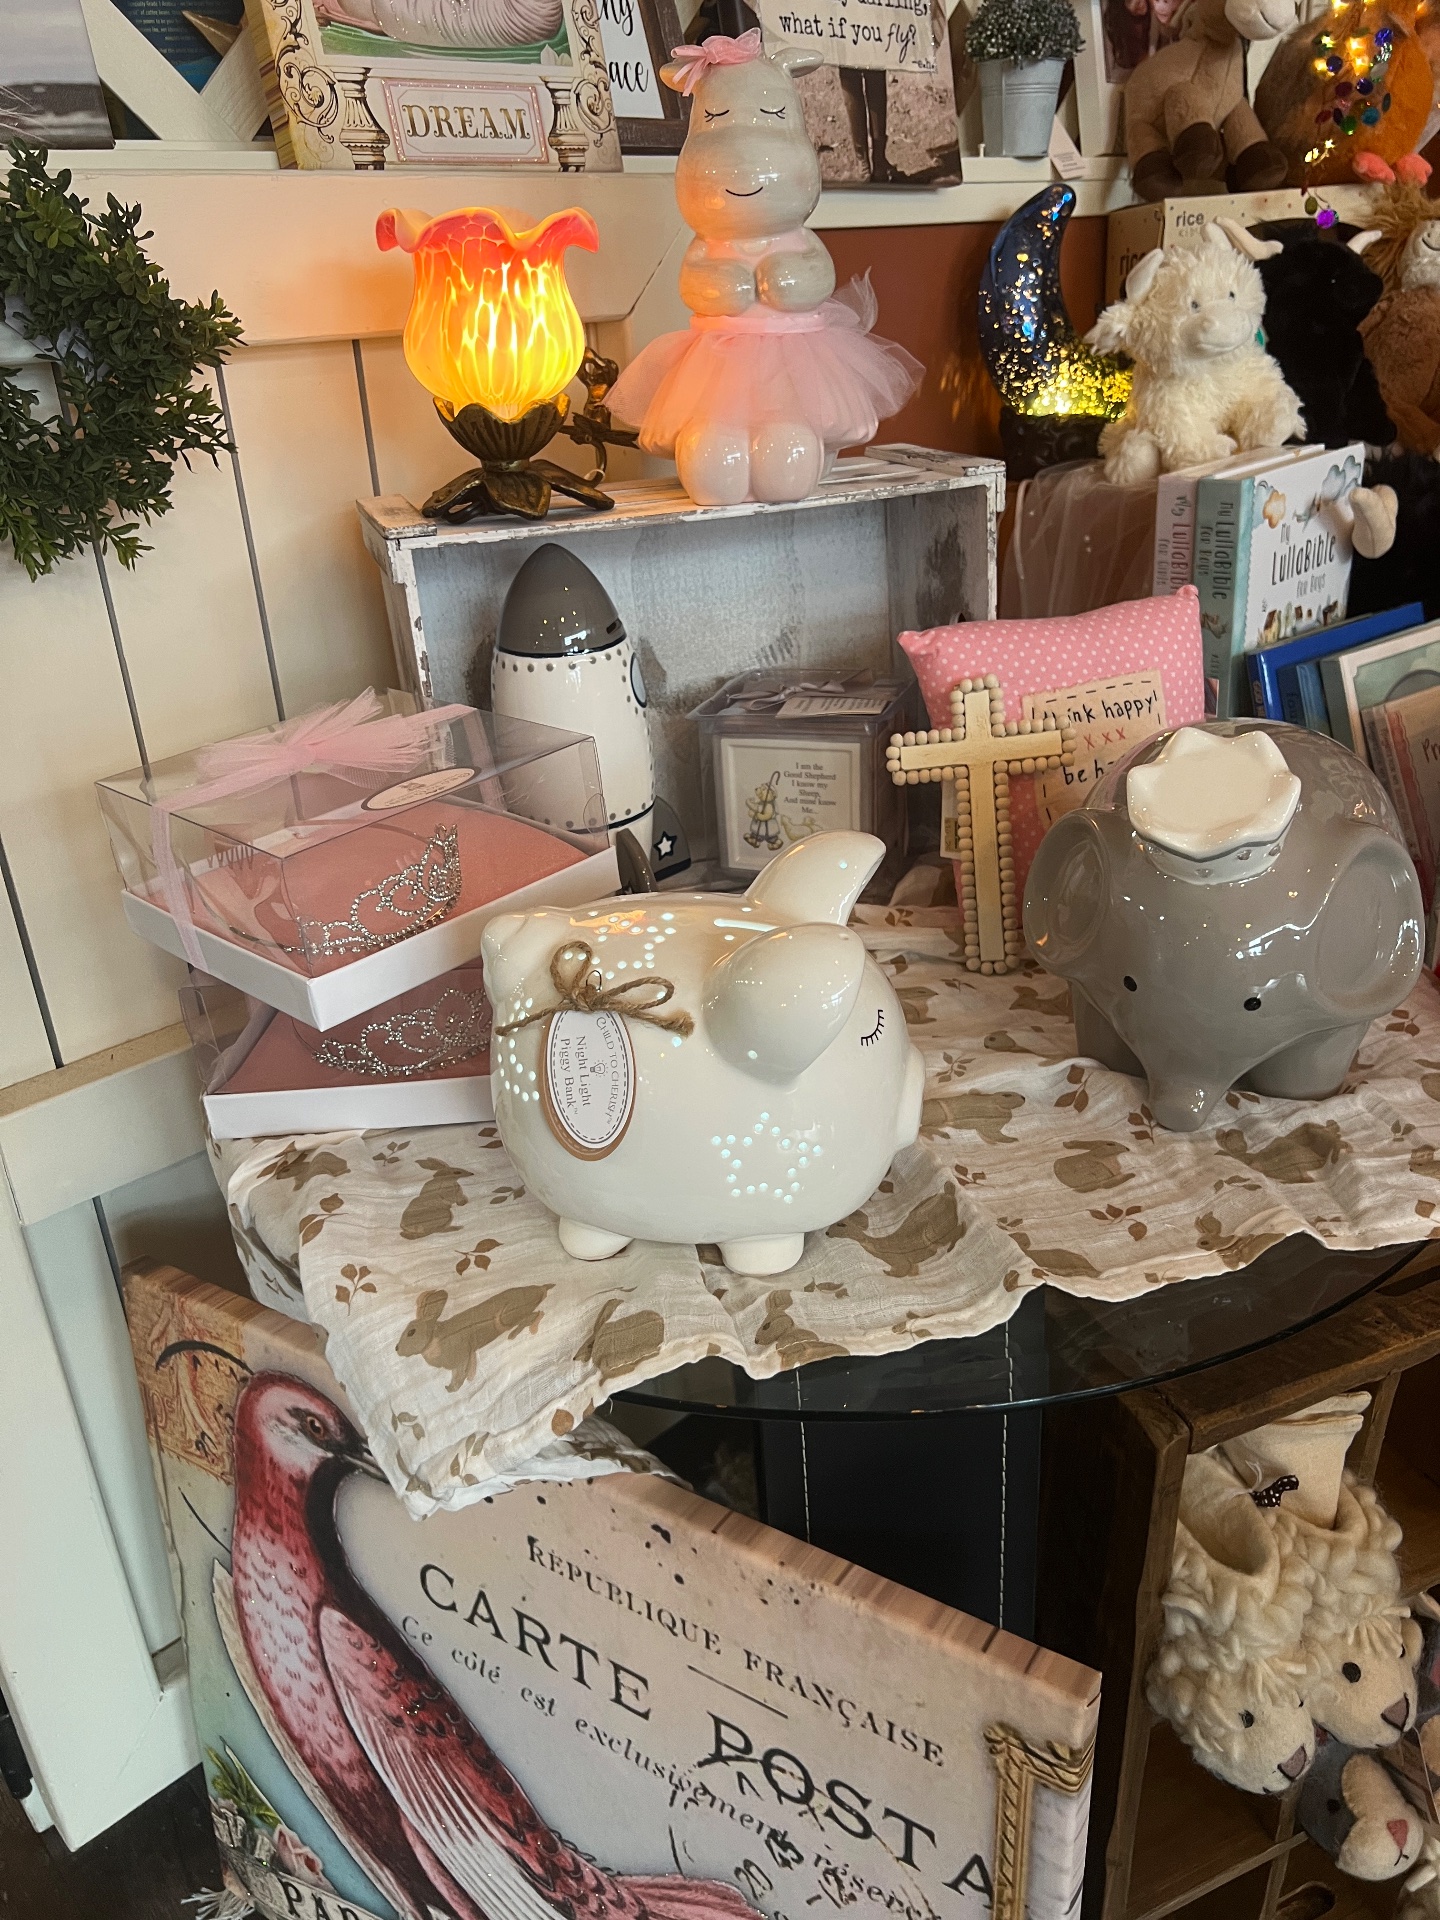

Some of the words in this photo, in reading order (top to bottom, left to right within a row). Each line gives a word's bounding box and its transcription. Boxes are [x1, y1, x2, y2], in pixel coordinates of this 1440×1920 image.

[858, 0, 927, 16] ring,
[779, 12, 823, 37] what
[828, 17, 847, 39] if
[850, 24, 882, 45] you
[885, 23, 916, 63] fly?
[402, 104, 530, 140] DREAM
[1176, 211, 1205, 227] rice
[1170, 522, 1192, 591] LullaBibl
[1212, 522, 1235, 600] LullaBible
[1272, 531, 1336, 586] LullaBible
[1043, 704, 1096, 724] ink
[1102, 696, 1153, 720] happy
[1421, 738, 1440, 763] Pr
[797, 780, 815, 788] know
[804, 772, 836, 781] Shepherd
[559, 1038, 571, 1073] Piggy
[575, 1035, 588, 1070] Night
[609, 1052, 618, 1069] TO
[578, 1074, 592, 1106] Light
[419, 1563, 652, 1721] CARTE
[401, 1615, 433, 1647] Ce
[520, 1687, 557, 1717] est
[743, 1648, 944, 1767] FRANÇAISE
